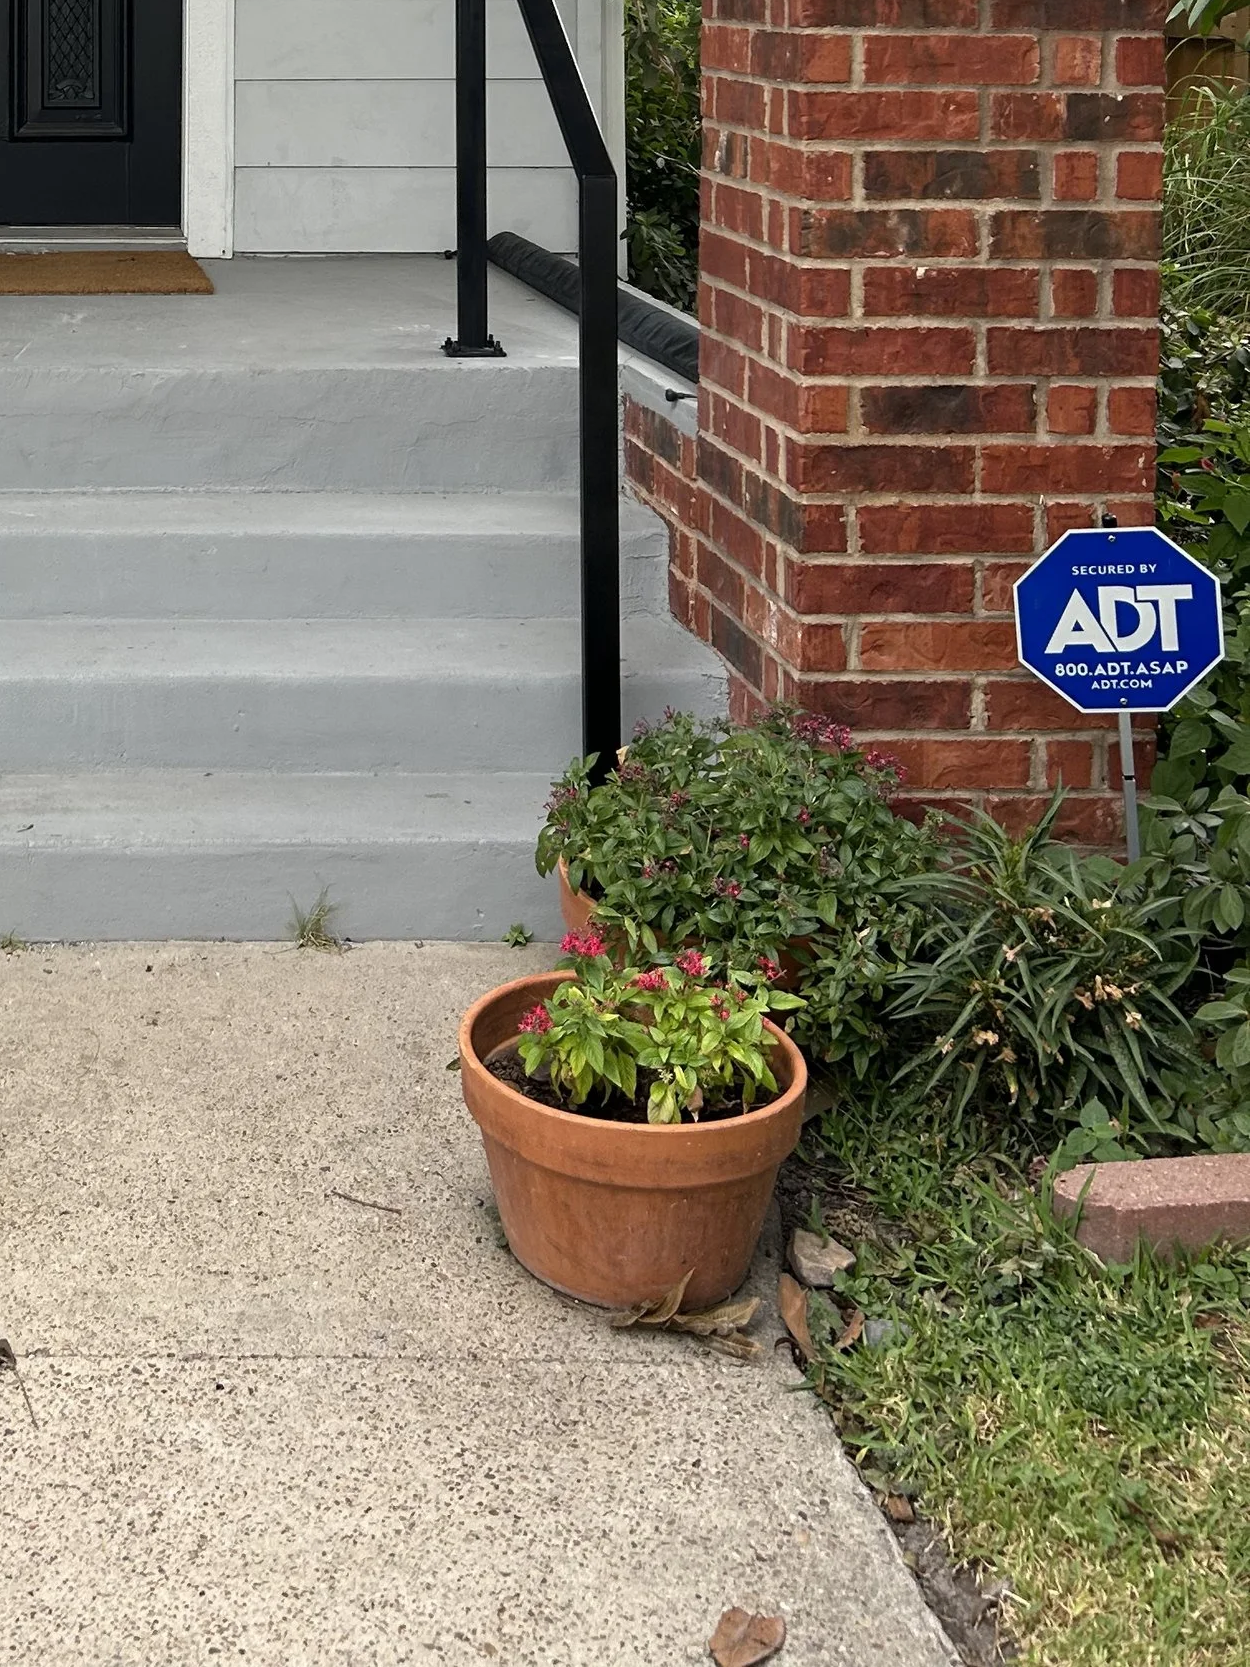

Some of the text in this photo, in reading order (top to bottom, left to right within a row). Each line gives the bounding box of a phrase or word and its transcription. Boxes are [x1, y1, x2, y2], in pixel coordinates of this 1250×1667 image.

[1071, 563, 1157, 576] SECURED BY
[1044, 583, 1193, 654] ADT
[1054, 660, 1189, 677] 800.ADT.ASAP
[1091, 678, 1153, 690] ADT.COM
